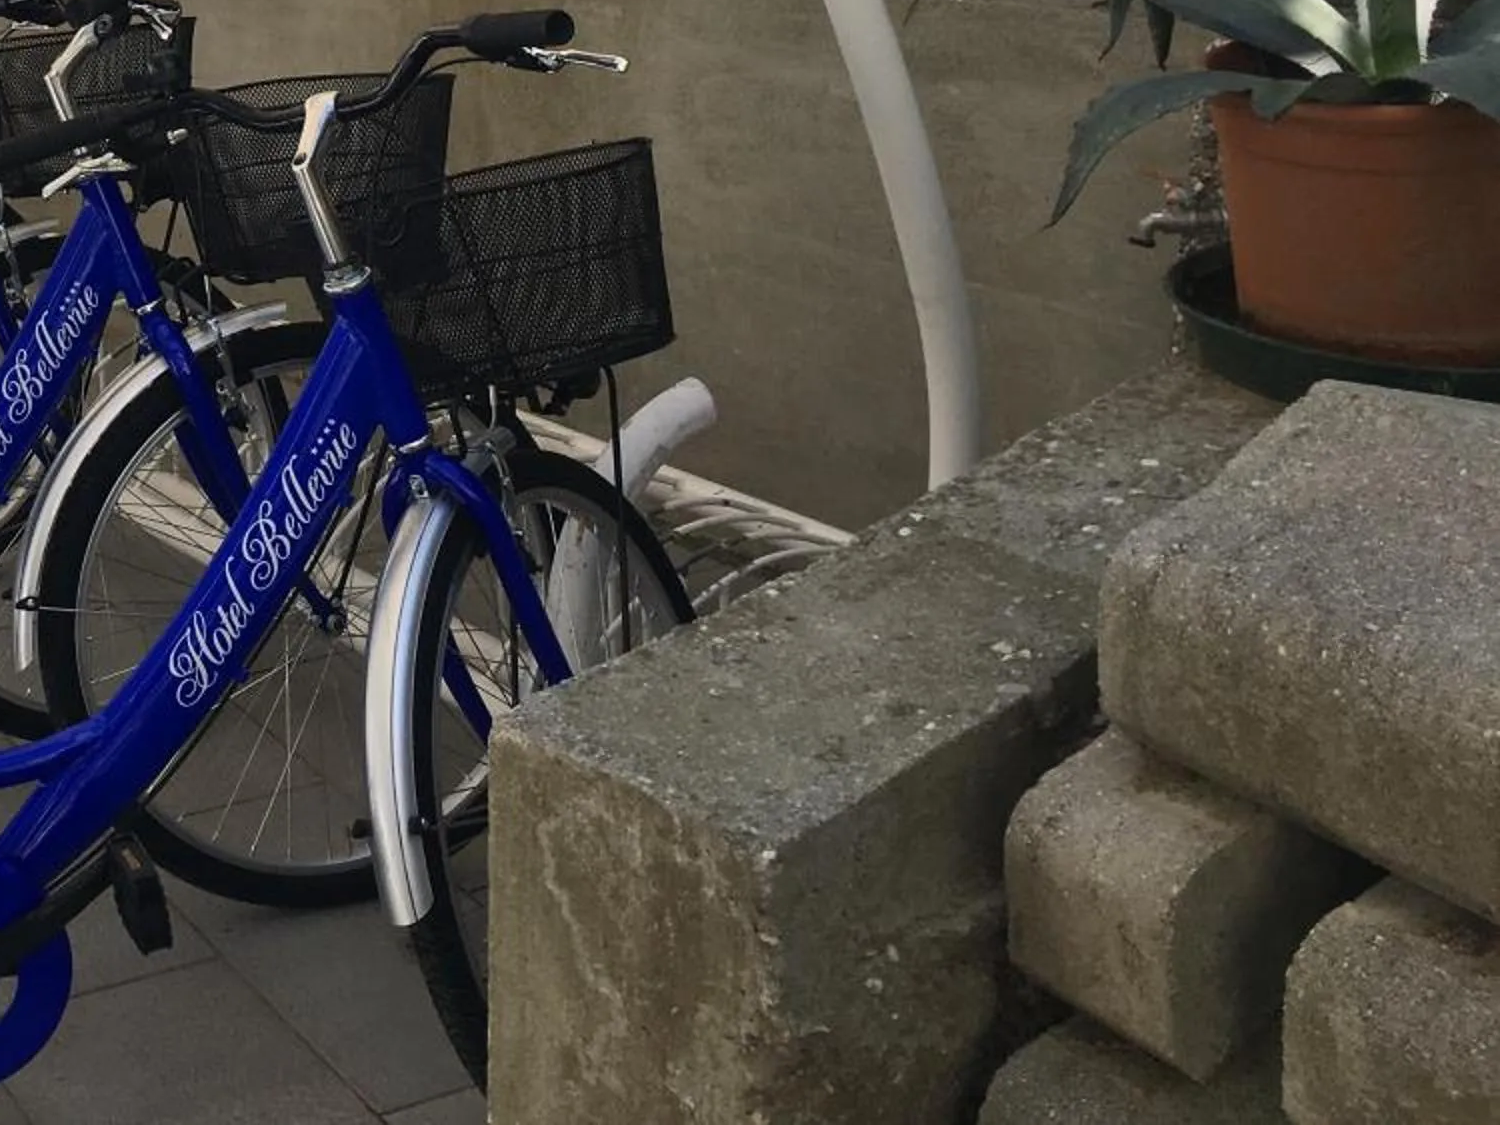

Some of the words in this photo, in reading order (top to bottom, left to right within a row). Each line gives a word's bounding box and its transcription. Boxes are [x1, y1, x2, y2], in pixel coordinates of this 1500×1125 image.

[2, 284, 99, 424] Bellevue
[168, 555, 256, 708] Hotel
[241, 422, 357, 592] Bellevue
